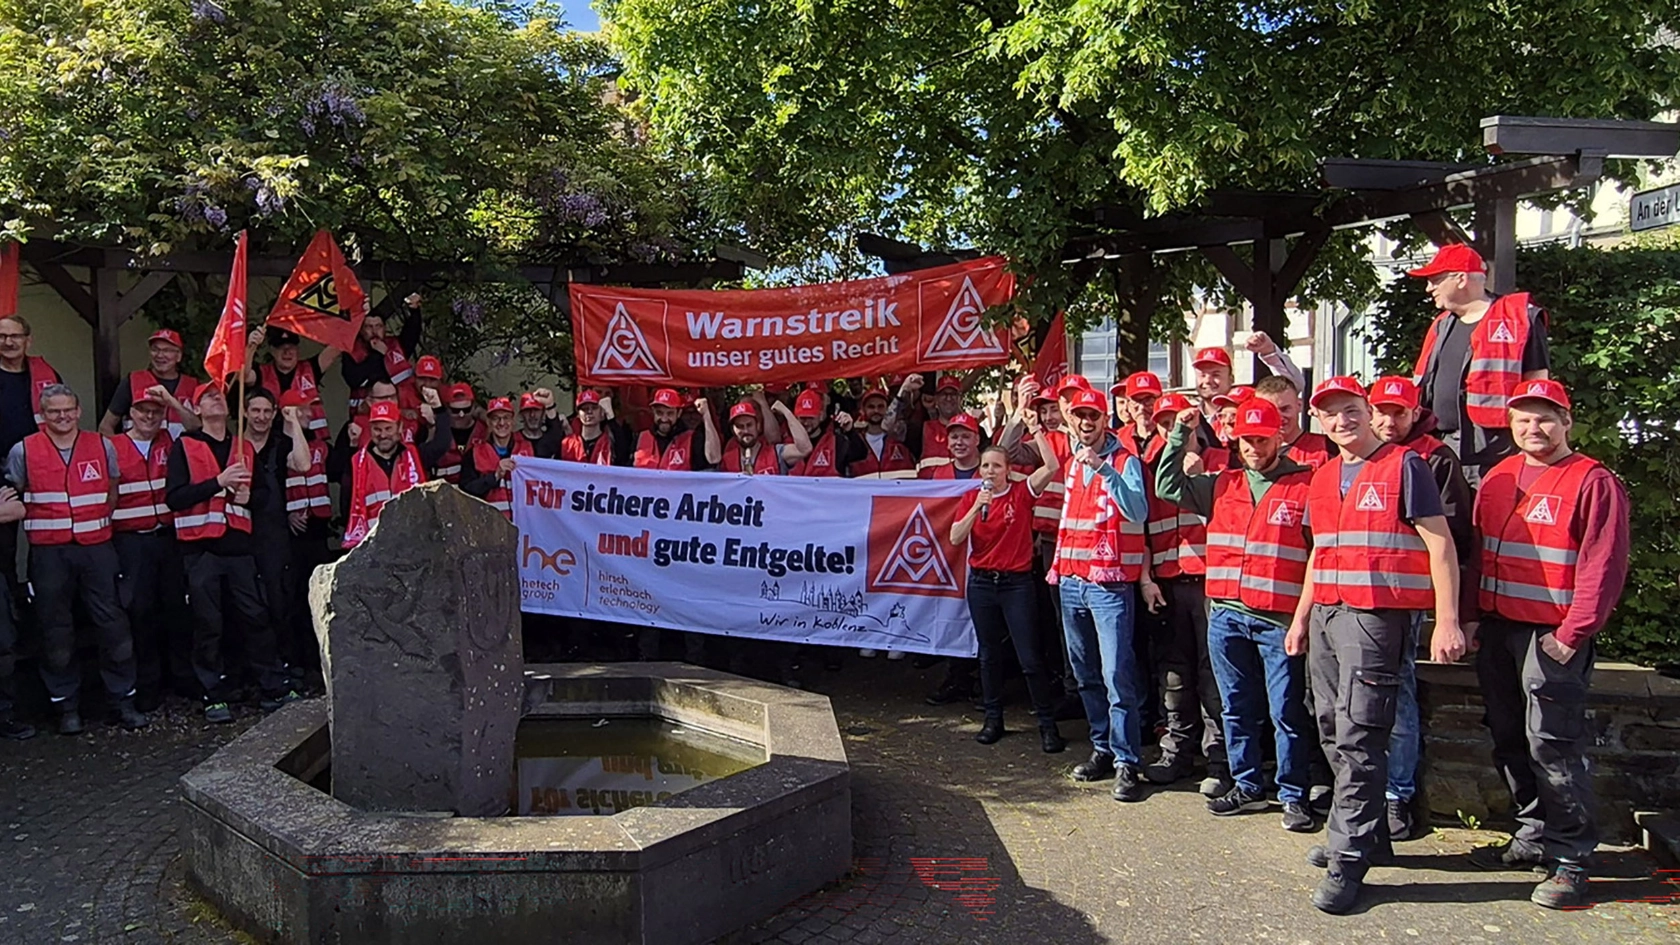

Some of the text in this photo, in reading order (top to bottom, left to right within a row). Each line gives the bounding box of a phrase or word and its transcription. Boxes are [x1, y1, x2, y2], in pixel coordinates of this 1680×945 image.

[1637, 201, 1650, 220] An
[1654, 197, 1671, 217] der
[685, 298, 900, 340] Warnstreik
[688, 336, 899, 370] unser gutes Recht
[525, 479, 765, 528] Für sichere Arbeit
[598, 530, 855, 578] und gute Entgelte!
[521, 577, 560, 591] hetech
[598, 570, 629, 585] hirsch
[522, 588, 555, 601] group
[599, 582, 652, 600] erlenbach
[599, 595, 660, 614] technology
[759, 612, 868, 633] Wir in Koblenz
